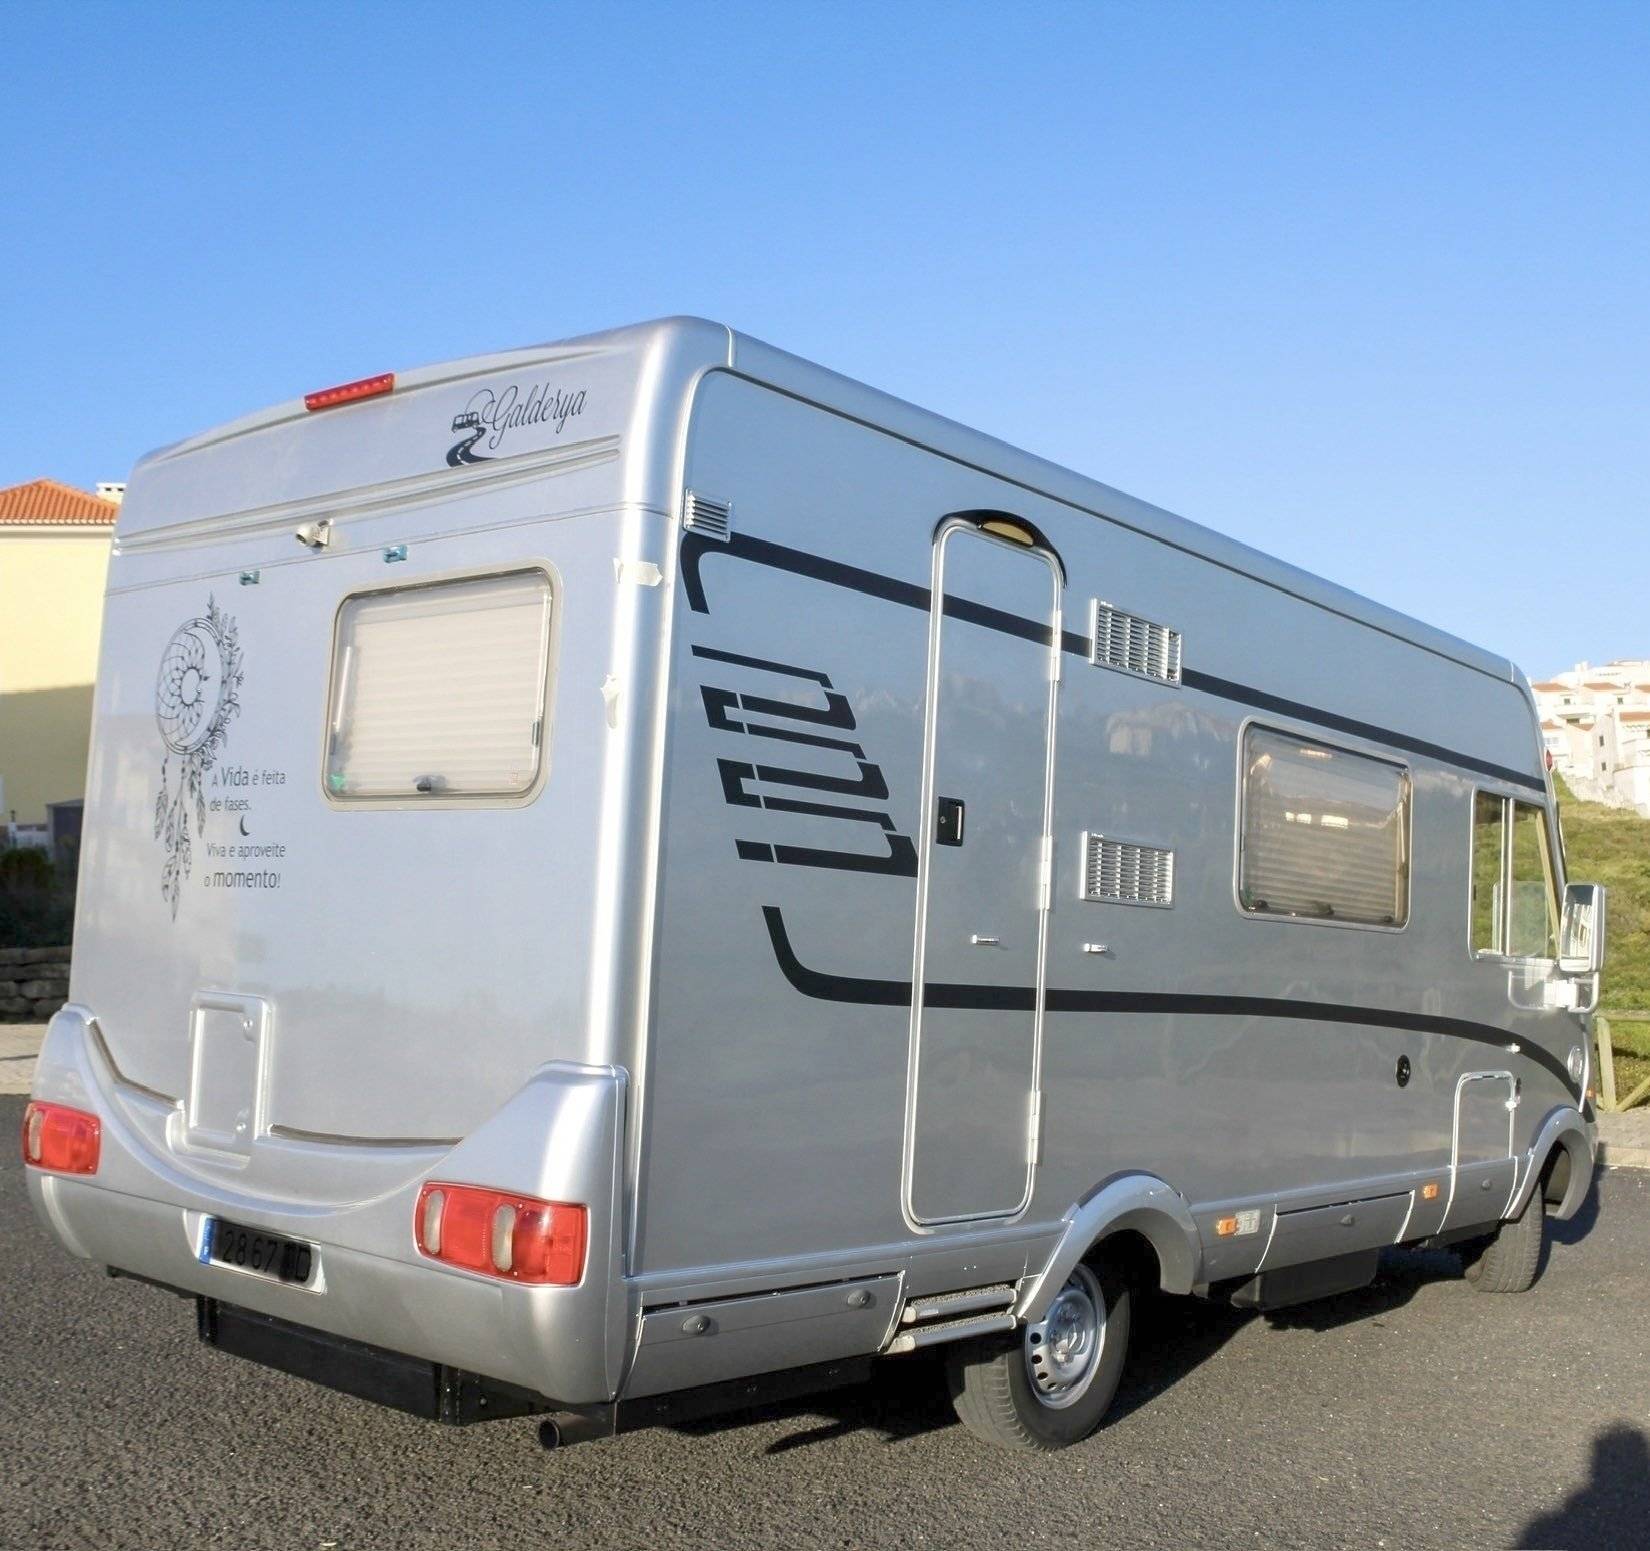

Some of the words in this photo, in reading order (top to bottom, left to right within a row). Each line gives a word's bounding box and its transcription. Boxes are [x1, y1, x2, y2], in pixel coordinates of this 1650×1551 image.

[212, 774, 218, 787] A
[221, 766, 249, 786] Vida
[262, 769, 286, 785] feita
[210, 797, 221, 811] de
[207, 842, 226, 857] Viva
[229, 846, 235, 857] e
[238, 842, 286, 861] aproveite
[204, 876, 210, 887] o
